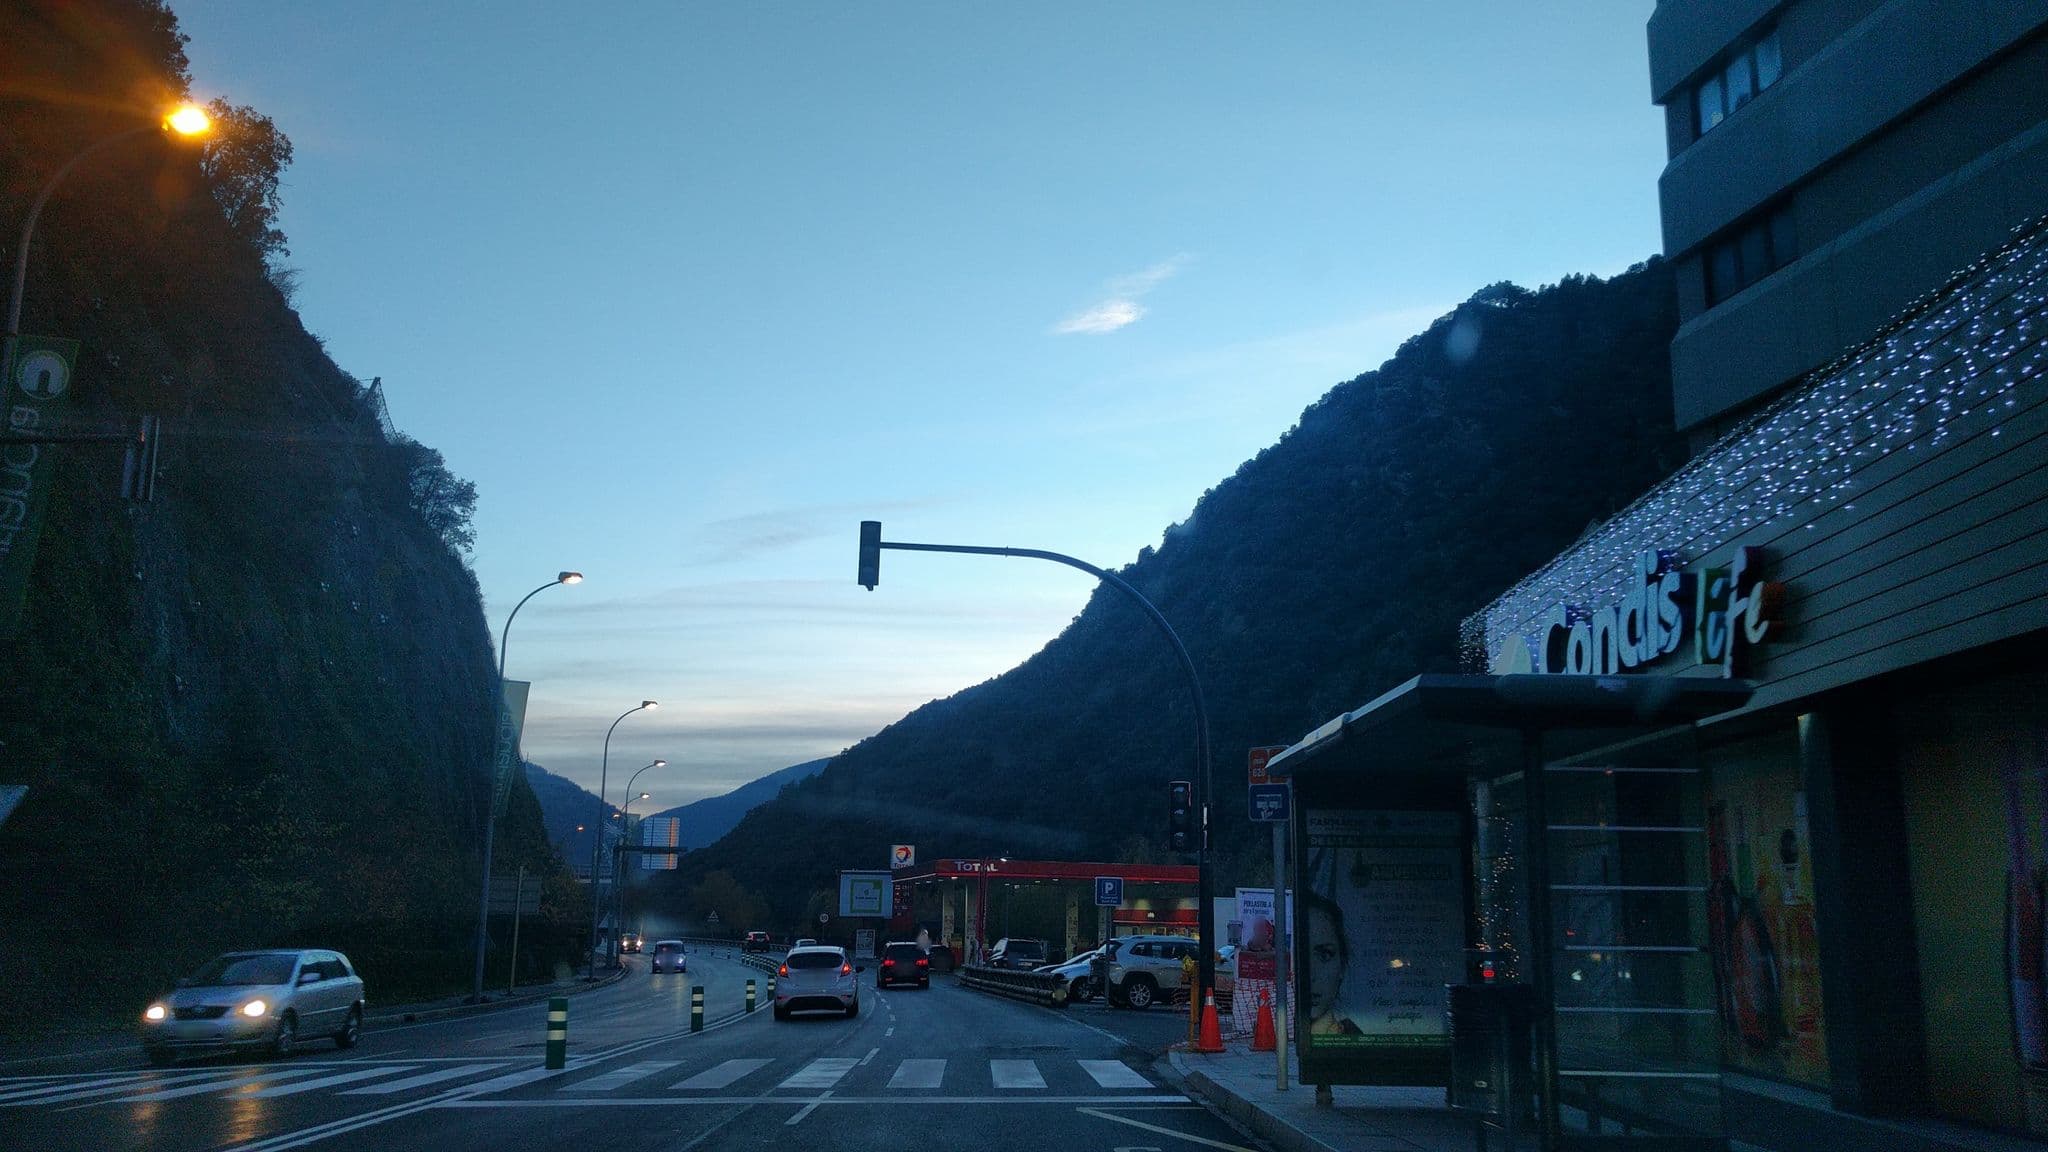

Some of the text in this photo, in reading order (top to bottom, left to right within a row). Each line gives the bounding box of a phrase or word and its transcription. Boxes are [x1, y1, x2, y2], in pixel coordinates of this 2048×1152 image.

[1540, 550, 1683, 675] Condis
[954, 861, 998, 872] TOTAL
[1104, 881, 1114, 894] P
